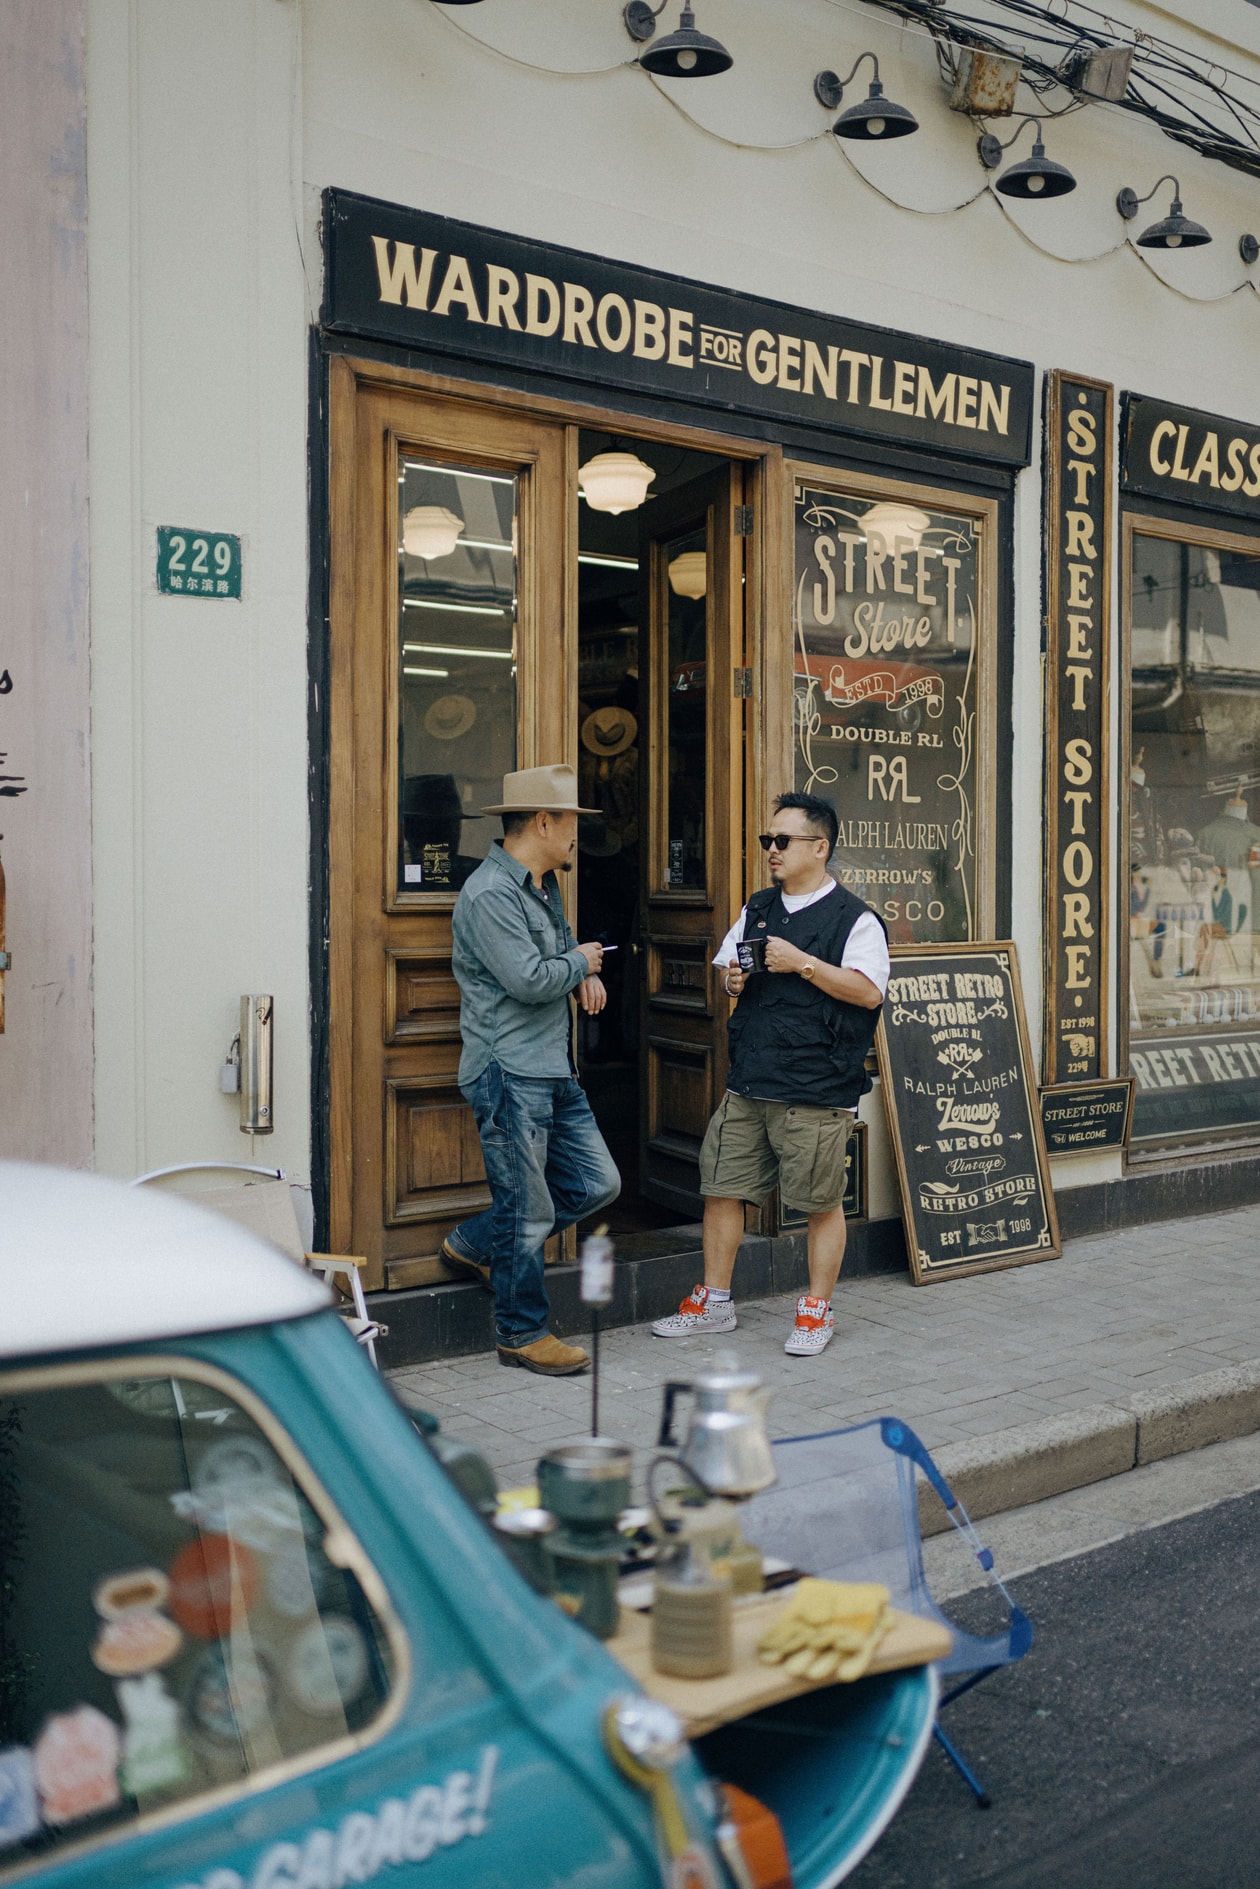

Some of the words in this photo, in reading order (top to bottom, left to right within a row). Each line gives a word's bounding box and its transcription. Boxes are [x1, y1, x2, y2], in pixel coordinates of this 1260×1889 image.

[371, 234, 694, 370] WARDROBE
[700, 332, 743, 364] FOR
[745, 328, 1011, 436] GENTLEMEN
[168, 535, 231, 576] 229
[1065, 409, 1097, 712] STREET
[170, 575, 229, 594] 哈尔滨路
[813, 530, 962, 642] STREET
[844, 601, 932, 659] Store
[845, 676, 883, 702] ESTD
[902, 679, 933, 704] 1998
[831, 725, 912, 745] DOUBLE
[917, 733, 943, 748] RL
[884, 822, 948, 851] LAUREN
[841, 868, 932, 885] ZERROW'S
[1062, 738, 1095, 990] STORE
[866, 900, 945, 922] SCO
[887, 973, 950, 1004] STREET
[954, 972, 1004, 999] RETRO
[926, 1001, 978, 1027] STORE
[1060, 1018, 1077, 1030] EST
[1078, 1016, 1095, 1028] 1998
[931, 1028, 969, 1045] DOUBLE
[971, 1029, 983, 1042] RL
[903, 1076, 957, 1096] RALPH
[963, 1065, 1018, 1095] LAUREN
[1045, 1105, 1088, 1122] STREET
[1088, 1101, 1124, 1116] STORE
[936, 1133, 1004, 1153] WESCO
[1068, 1128, 1107, 1143] WELCOME
[949, 1157, 1001, 1175] Vintage
[919, 1194, 979, 1212] RETRO
[984, 1177, 1037, 1203] STORE
[940, 1230, 962, 1246] EST
[1008, 1218, 1031, 1234] 1998
[254, 1744, 498, 1889] GARAGE!
